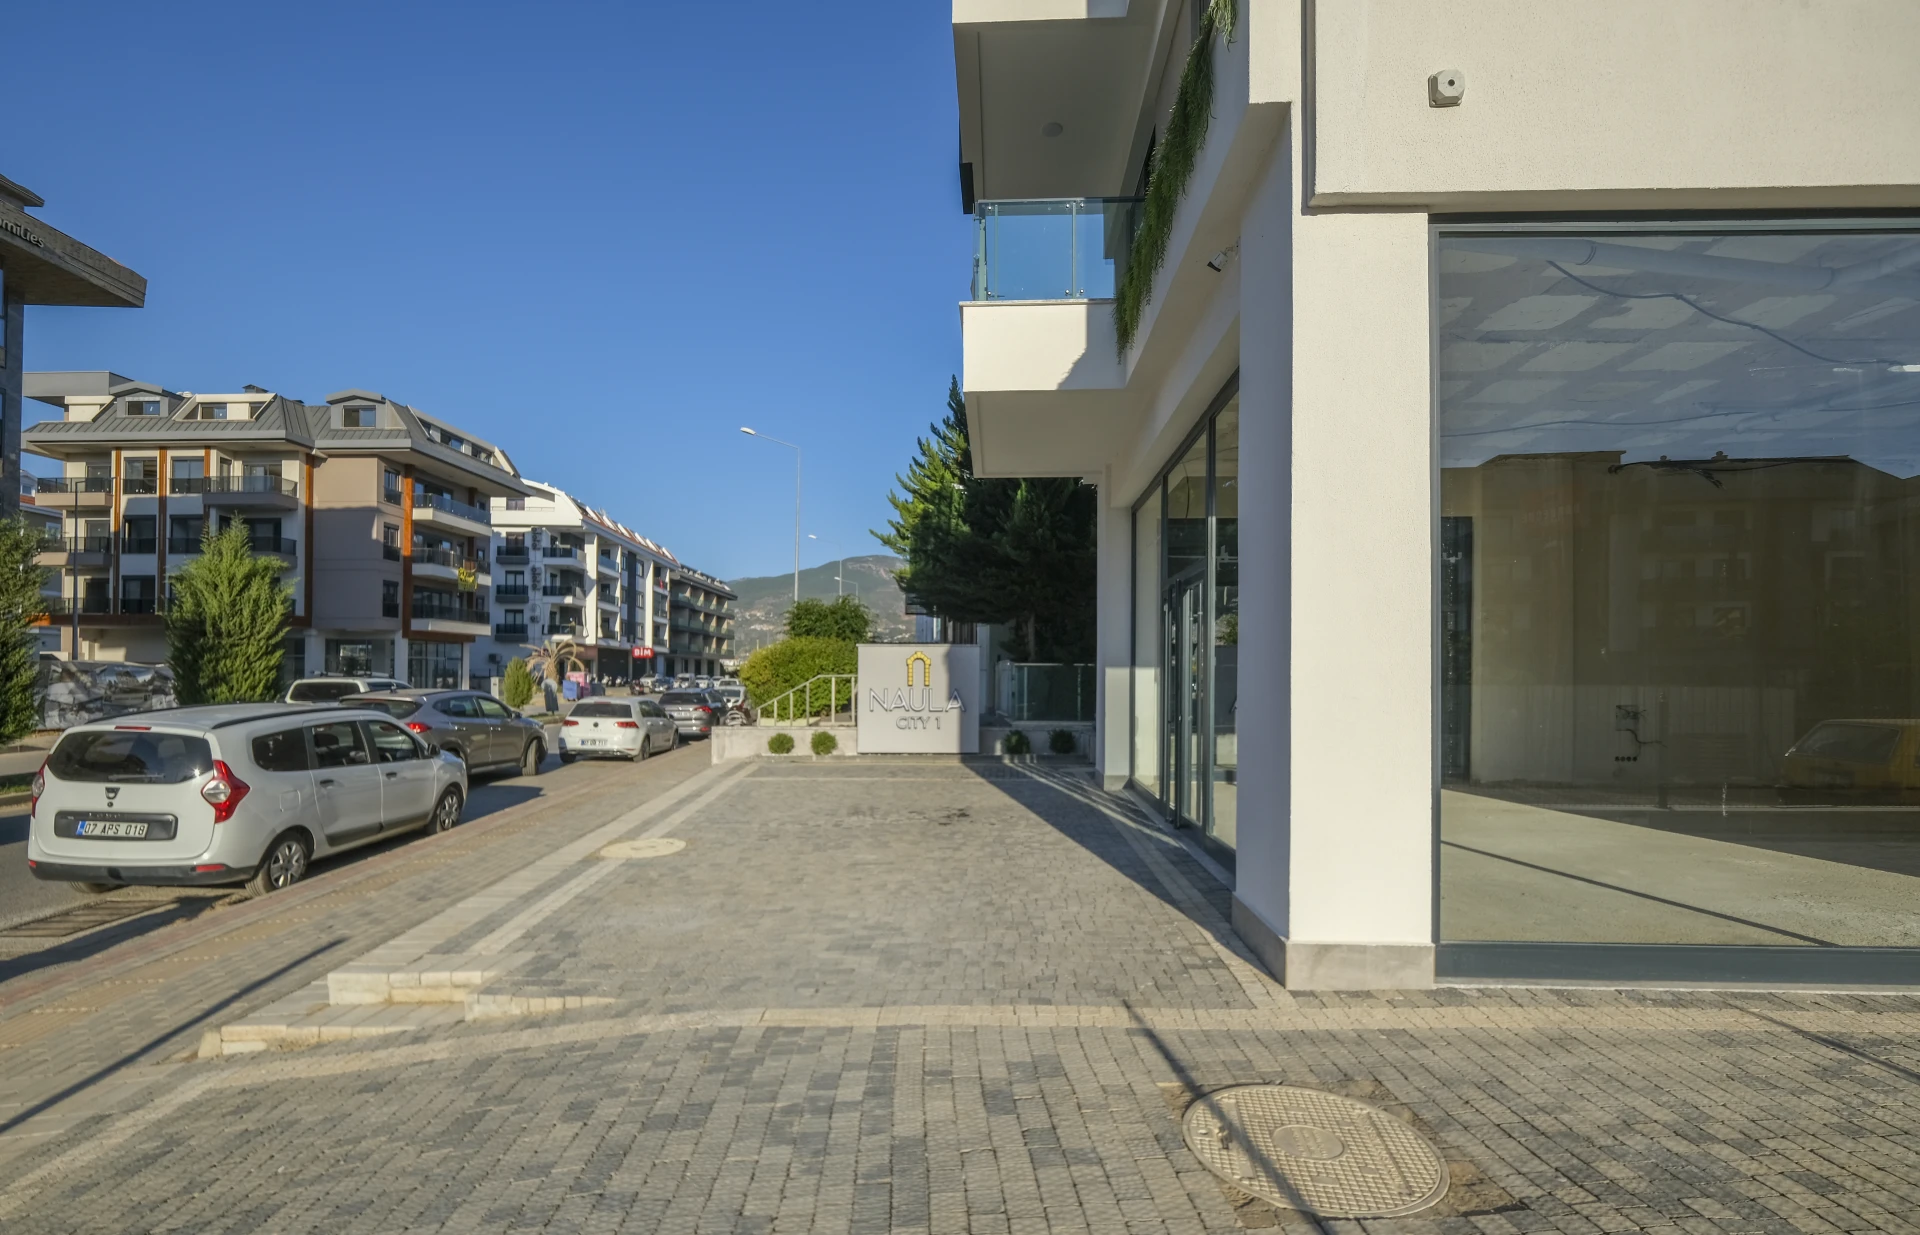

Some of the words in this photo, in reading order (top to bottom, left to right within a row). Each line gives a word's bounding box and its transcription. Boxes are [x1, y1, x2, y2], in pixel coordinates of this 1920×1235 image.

[869, 688, 966, 713] NAULA
[896, 716, 931, 730] CITY
[935, 716, 941, 730] 1
[84, 822, 97, 834] 07
[100, 823, 121, 835] APS
[125, 824, 146, 836] 018
